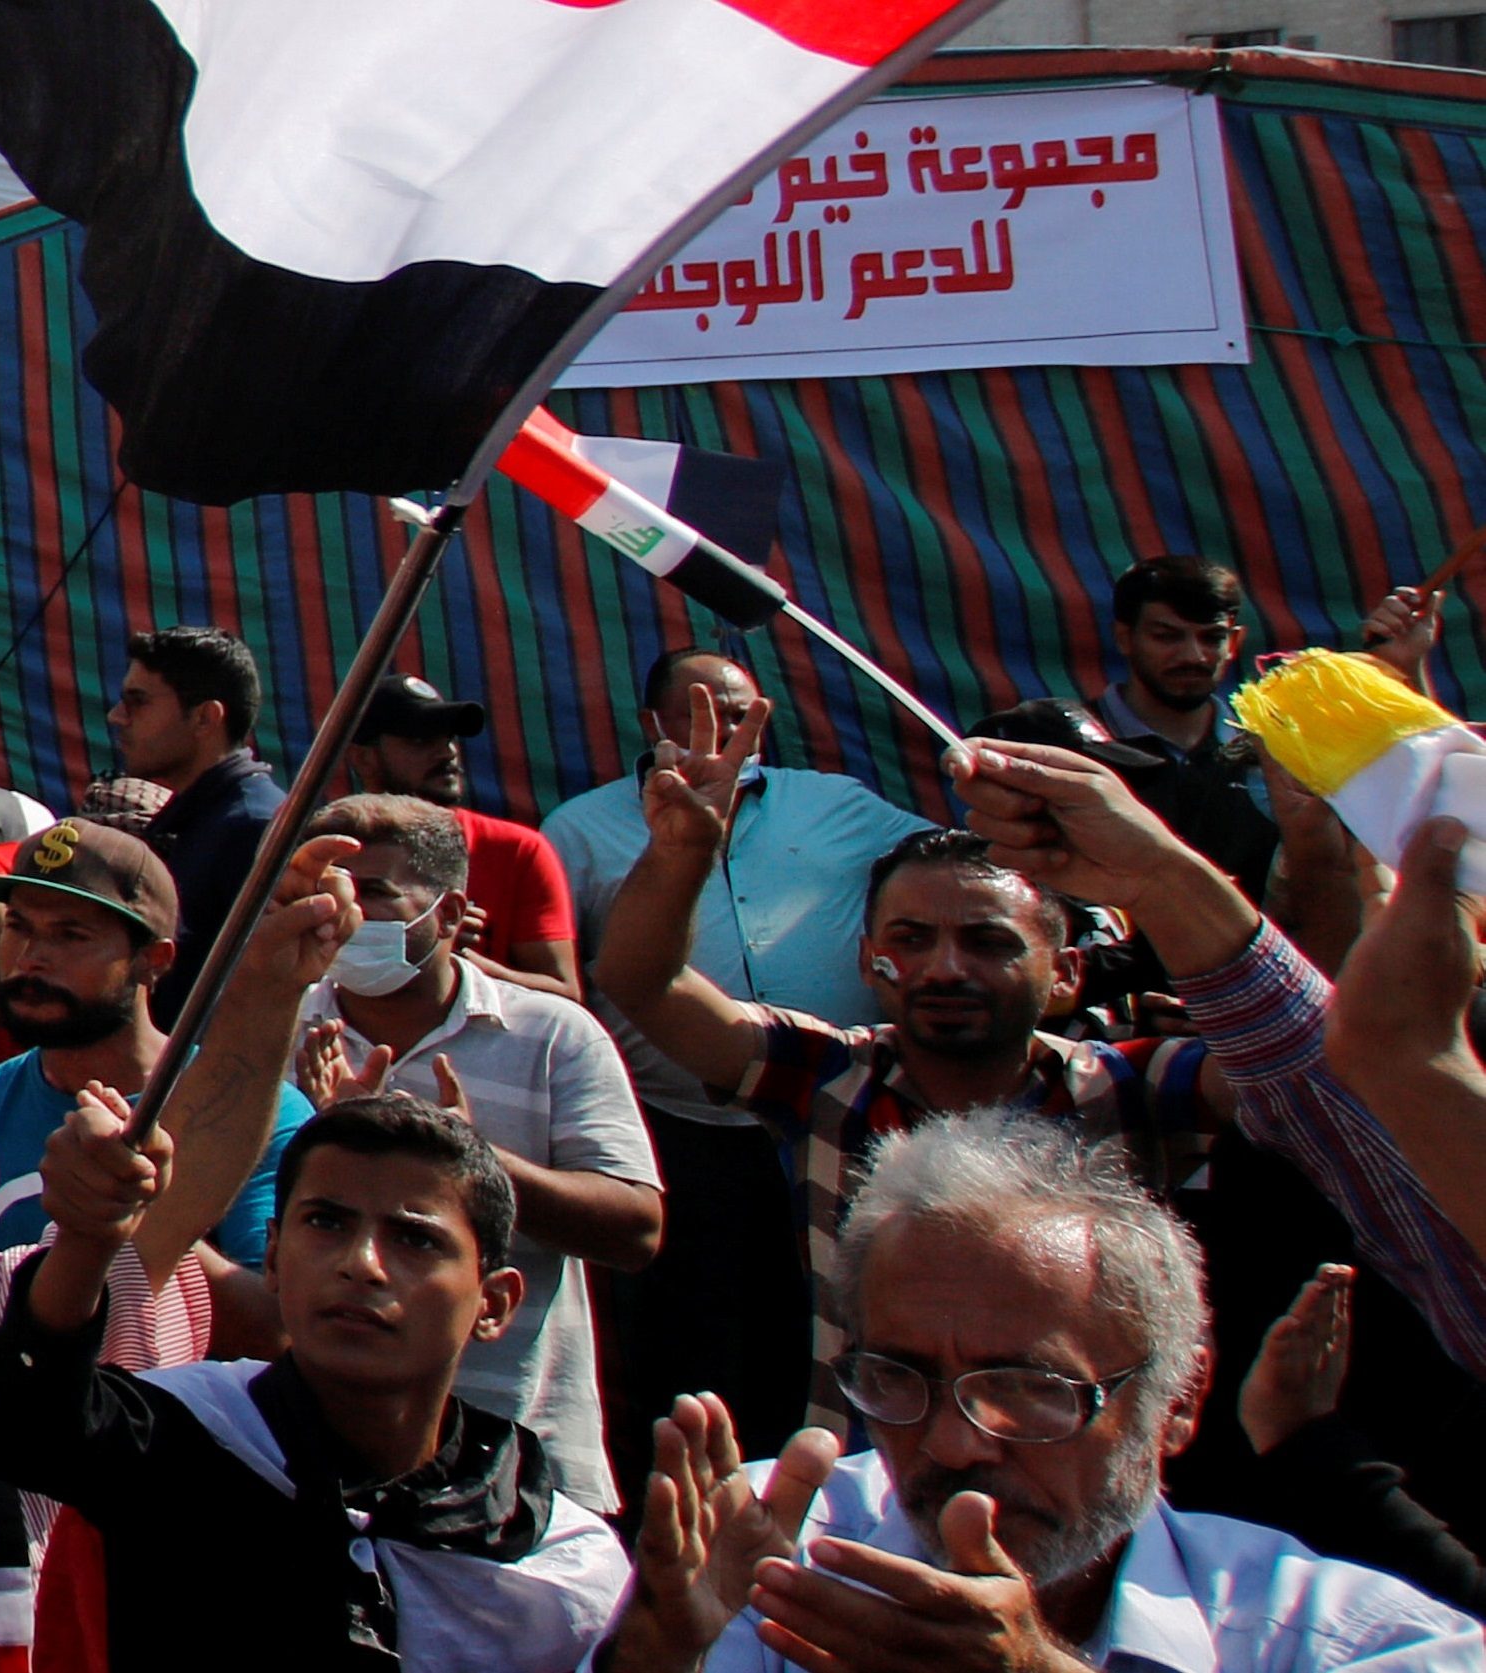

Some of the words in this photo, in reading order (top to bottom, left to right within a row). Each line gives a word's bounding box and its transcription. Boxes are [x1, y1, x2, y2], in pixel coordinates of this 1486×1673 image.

[773, 131, 890, 224] خيم
[907, 126, 1158, 210] مجموعة
[843, 218, 1014, 320] للدعم
